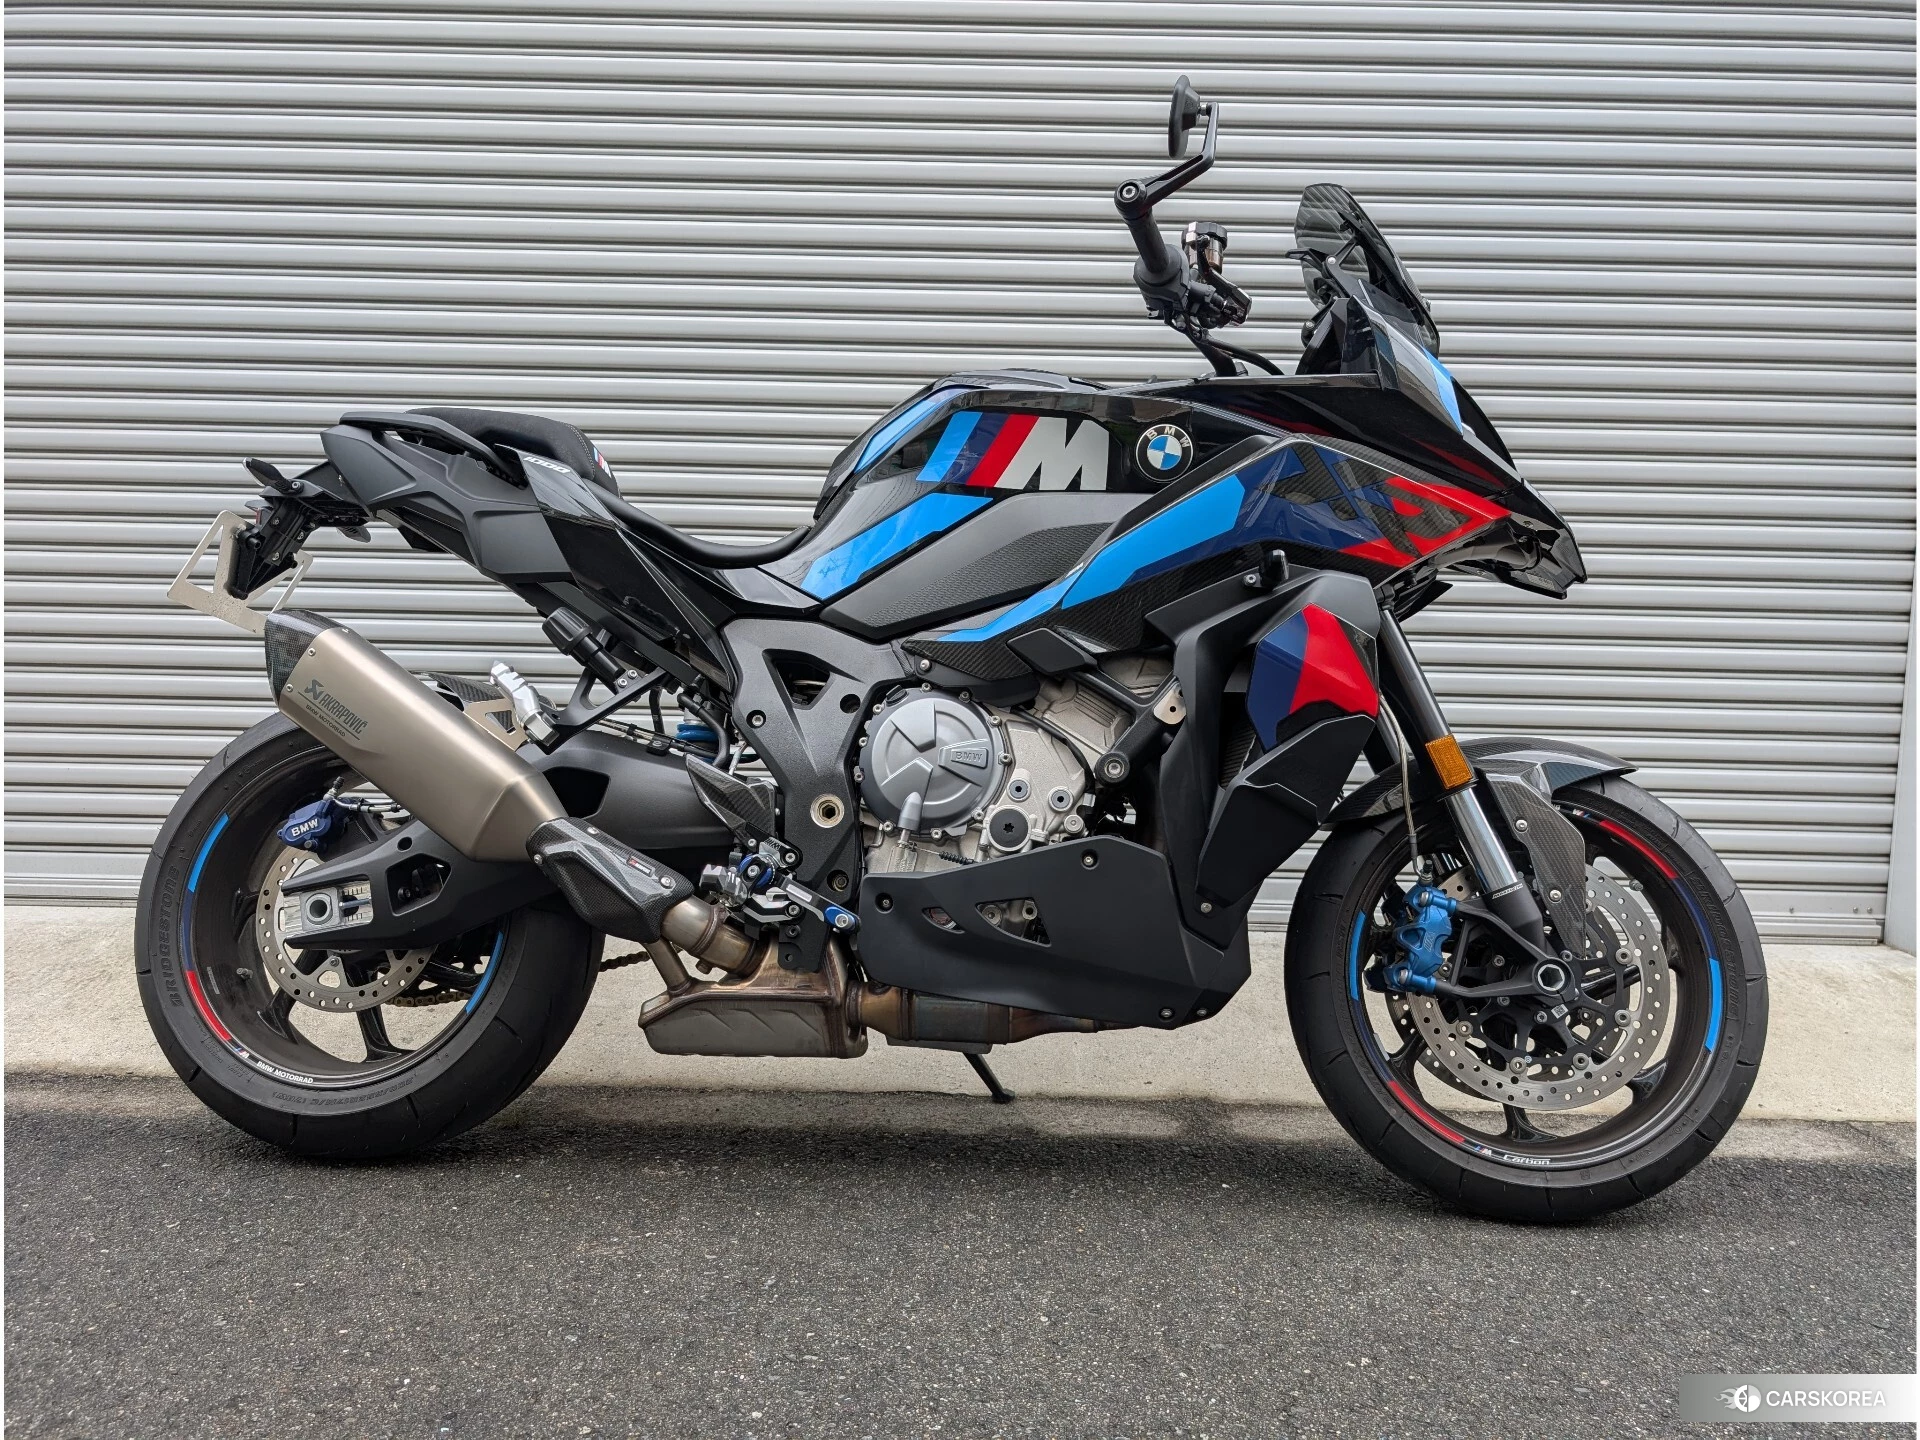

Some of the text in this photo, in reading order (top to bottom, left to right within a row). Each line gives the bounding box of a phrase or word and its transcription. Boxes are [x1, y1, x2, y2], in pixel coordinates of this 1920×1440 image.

[1146, 425, 1191, 448] BMW
[994, 416, 1109, 490] M
[318, 714, 346, 737] MOTORRAD
[955, 751, 983, 763] BMW
[291, 818, 319, 837] BMW
[159, 865, 185, 1008] BRIDGESTONE
[1690, 875, 1738, 1019] BRIDGESTONE
[256, 1060, 275, 1073] BMW
[273, 1069, 314, 1084] MOTORRAD
